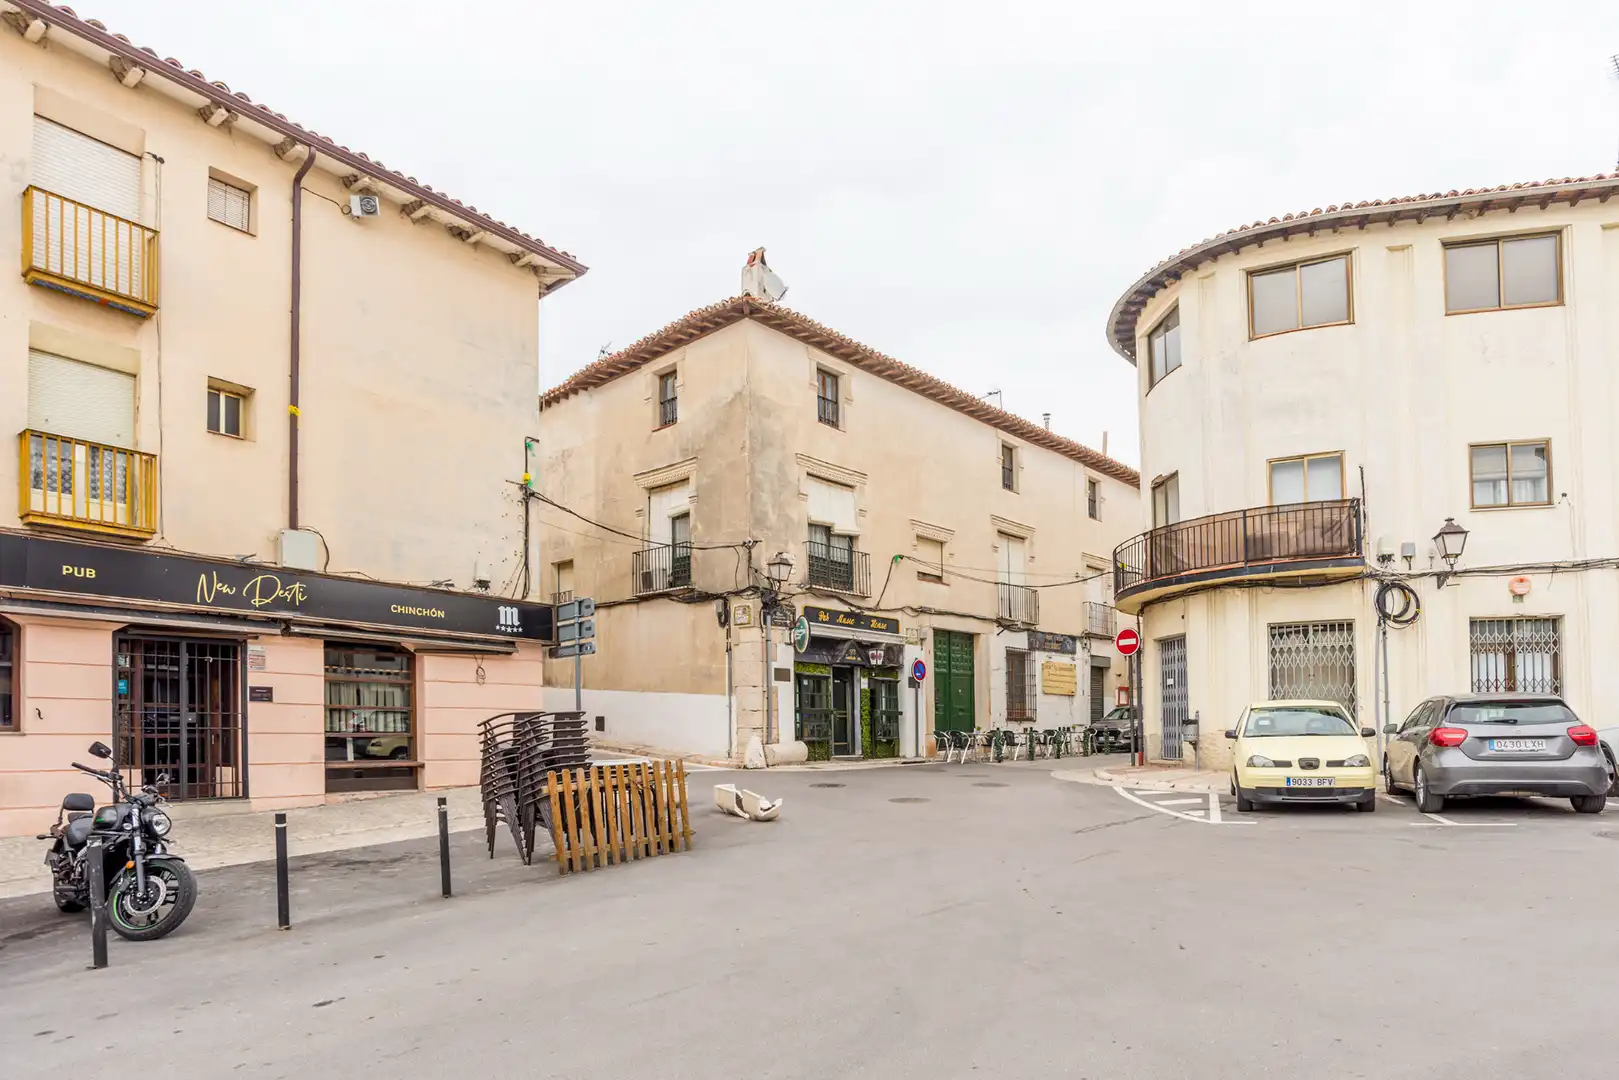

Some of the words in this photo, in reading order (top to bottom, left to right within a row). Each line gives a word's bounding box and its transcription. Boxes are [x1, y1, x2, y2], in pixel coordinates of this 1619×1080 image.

[62, 564, 97, 579] PUB
[196, 571, 236, 603] New
[390, 604, 445, 619] CHINCHÓN
[1496, 740, 1522, 749] 0430
[1524, 740, 1544, 749] LXH
[1291, 778, 1313, 786] 9033
